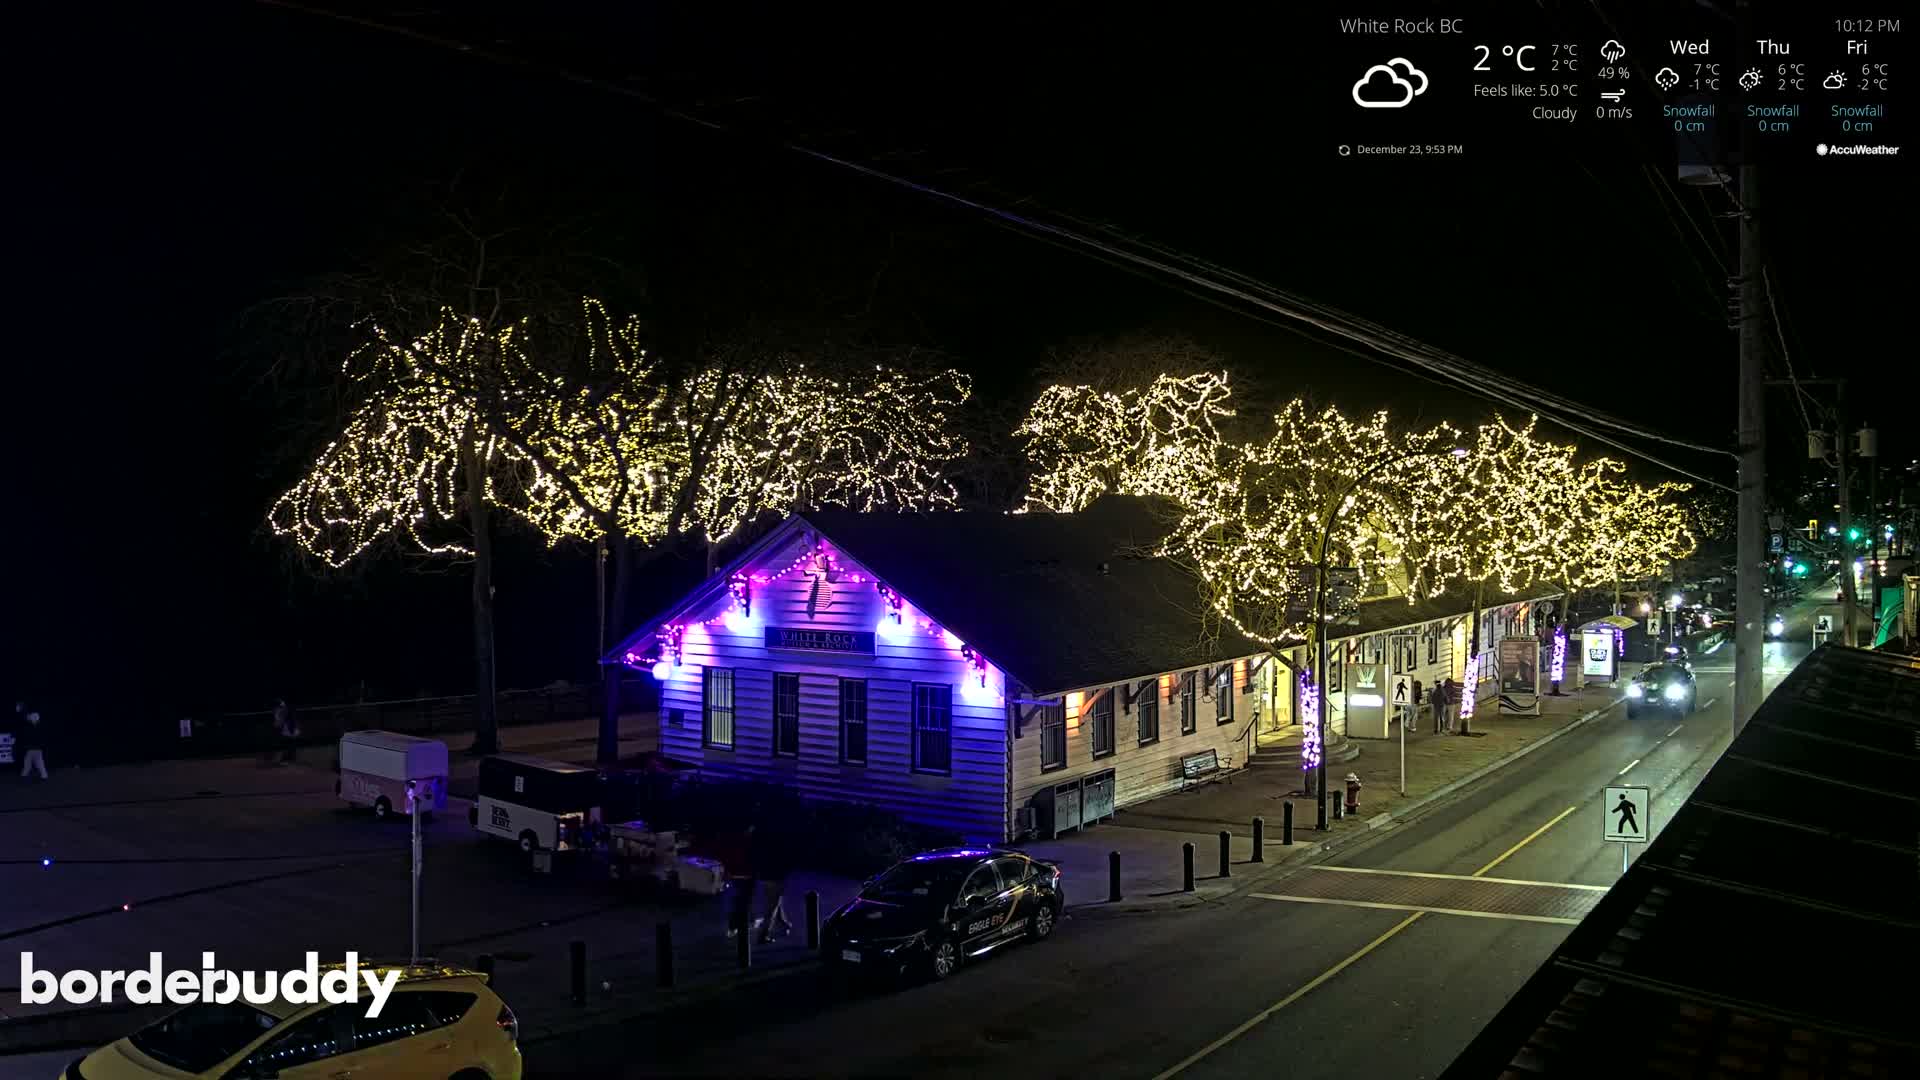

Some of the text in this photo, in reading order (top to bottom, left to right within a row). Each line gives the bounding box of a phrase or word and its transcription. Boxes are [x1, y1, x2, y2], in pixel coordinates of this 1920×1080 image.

[781, 631, 857, 644] WHITE ROCK
[968, 913, 1005, 935] EAGLE EYE
